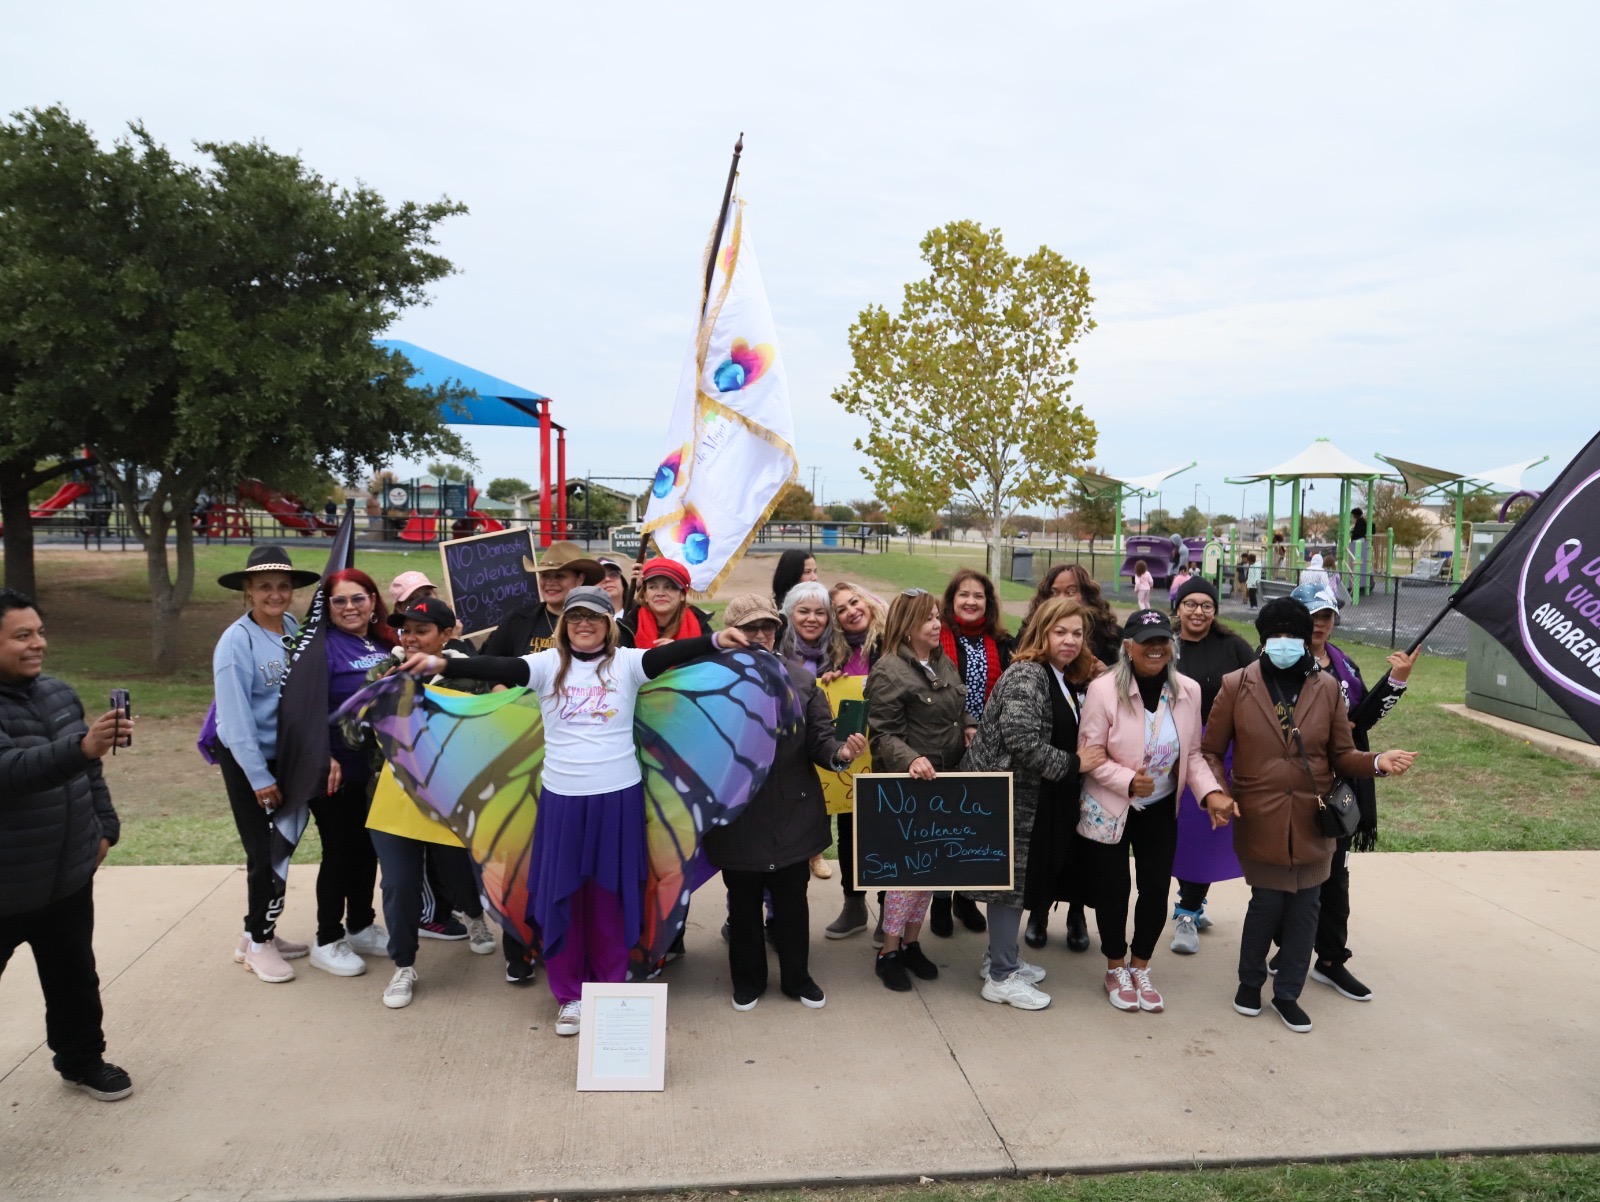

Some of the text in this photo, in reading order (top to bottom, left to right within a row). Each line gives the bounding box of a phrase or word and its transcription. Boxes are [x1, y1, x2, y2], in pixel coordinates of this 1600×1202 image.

[447, 539, 528, 571] NO Domestic
[453, 563, 520, 591] Violence
[455, 594, 479, 616] TO
[291, 626, 318, 662] TIME
[877, 780, 992, 816] No a La
[897, 817, 977, 842] Violencia
